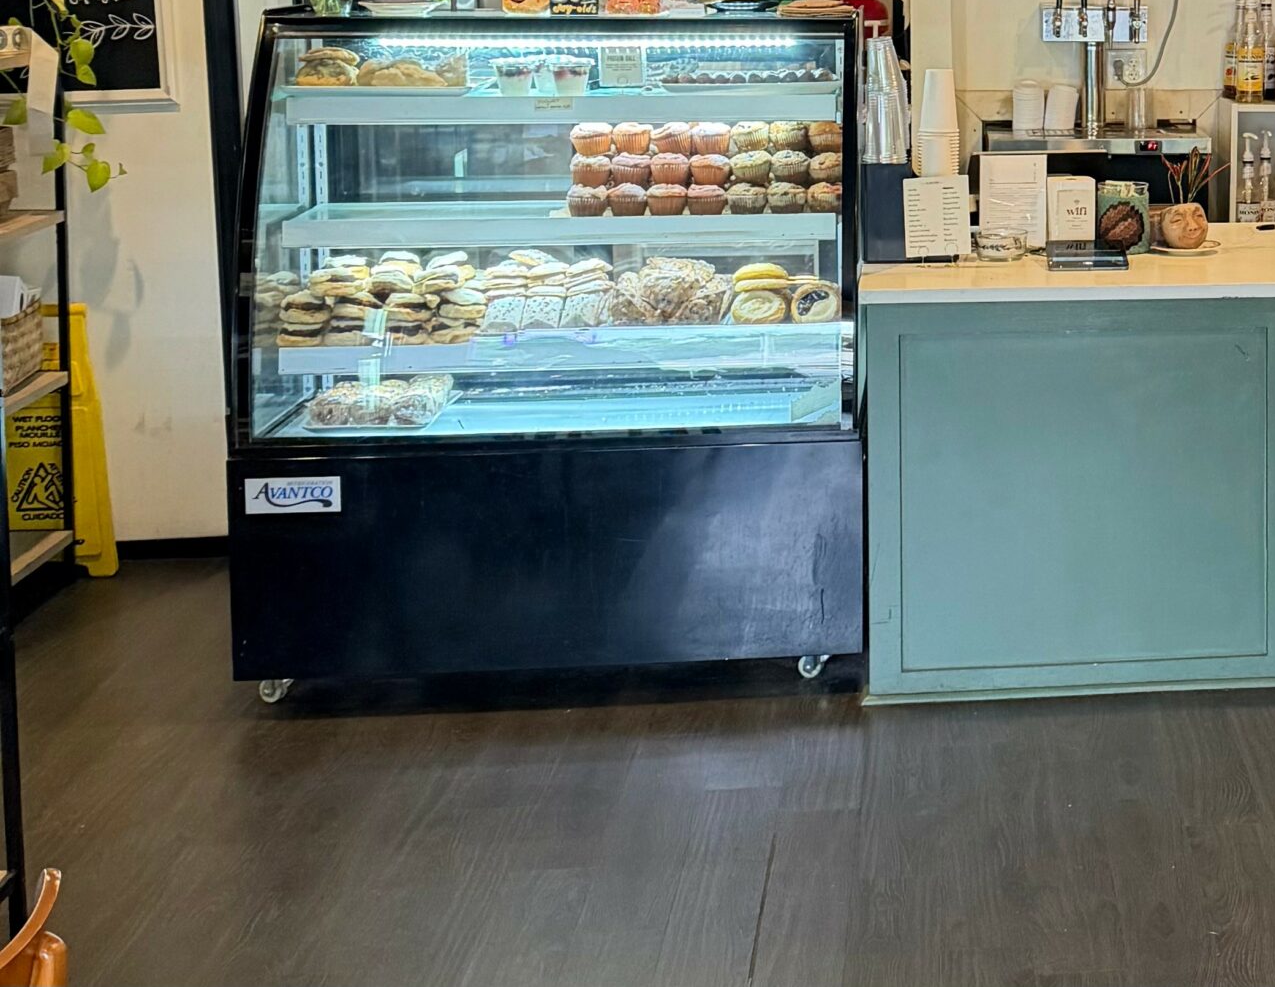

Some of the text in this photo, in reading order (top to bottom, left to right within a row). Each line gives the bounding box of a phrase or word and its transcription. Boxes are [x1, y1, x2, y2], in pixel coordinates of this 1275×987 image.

[1066, 206, 1088, 217] wifi
[35, 416, 62, 424] FLOO
[9, 440, 30, 448] PISO
[10, 467, 35, 503] CAUTION
[252, 481, 333, 506] AVANTCO
